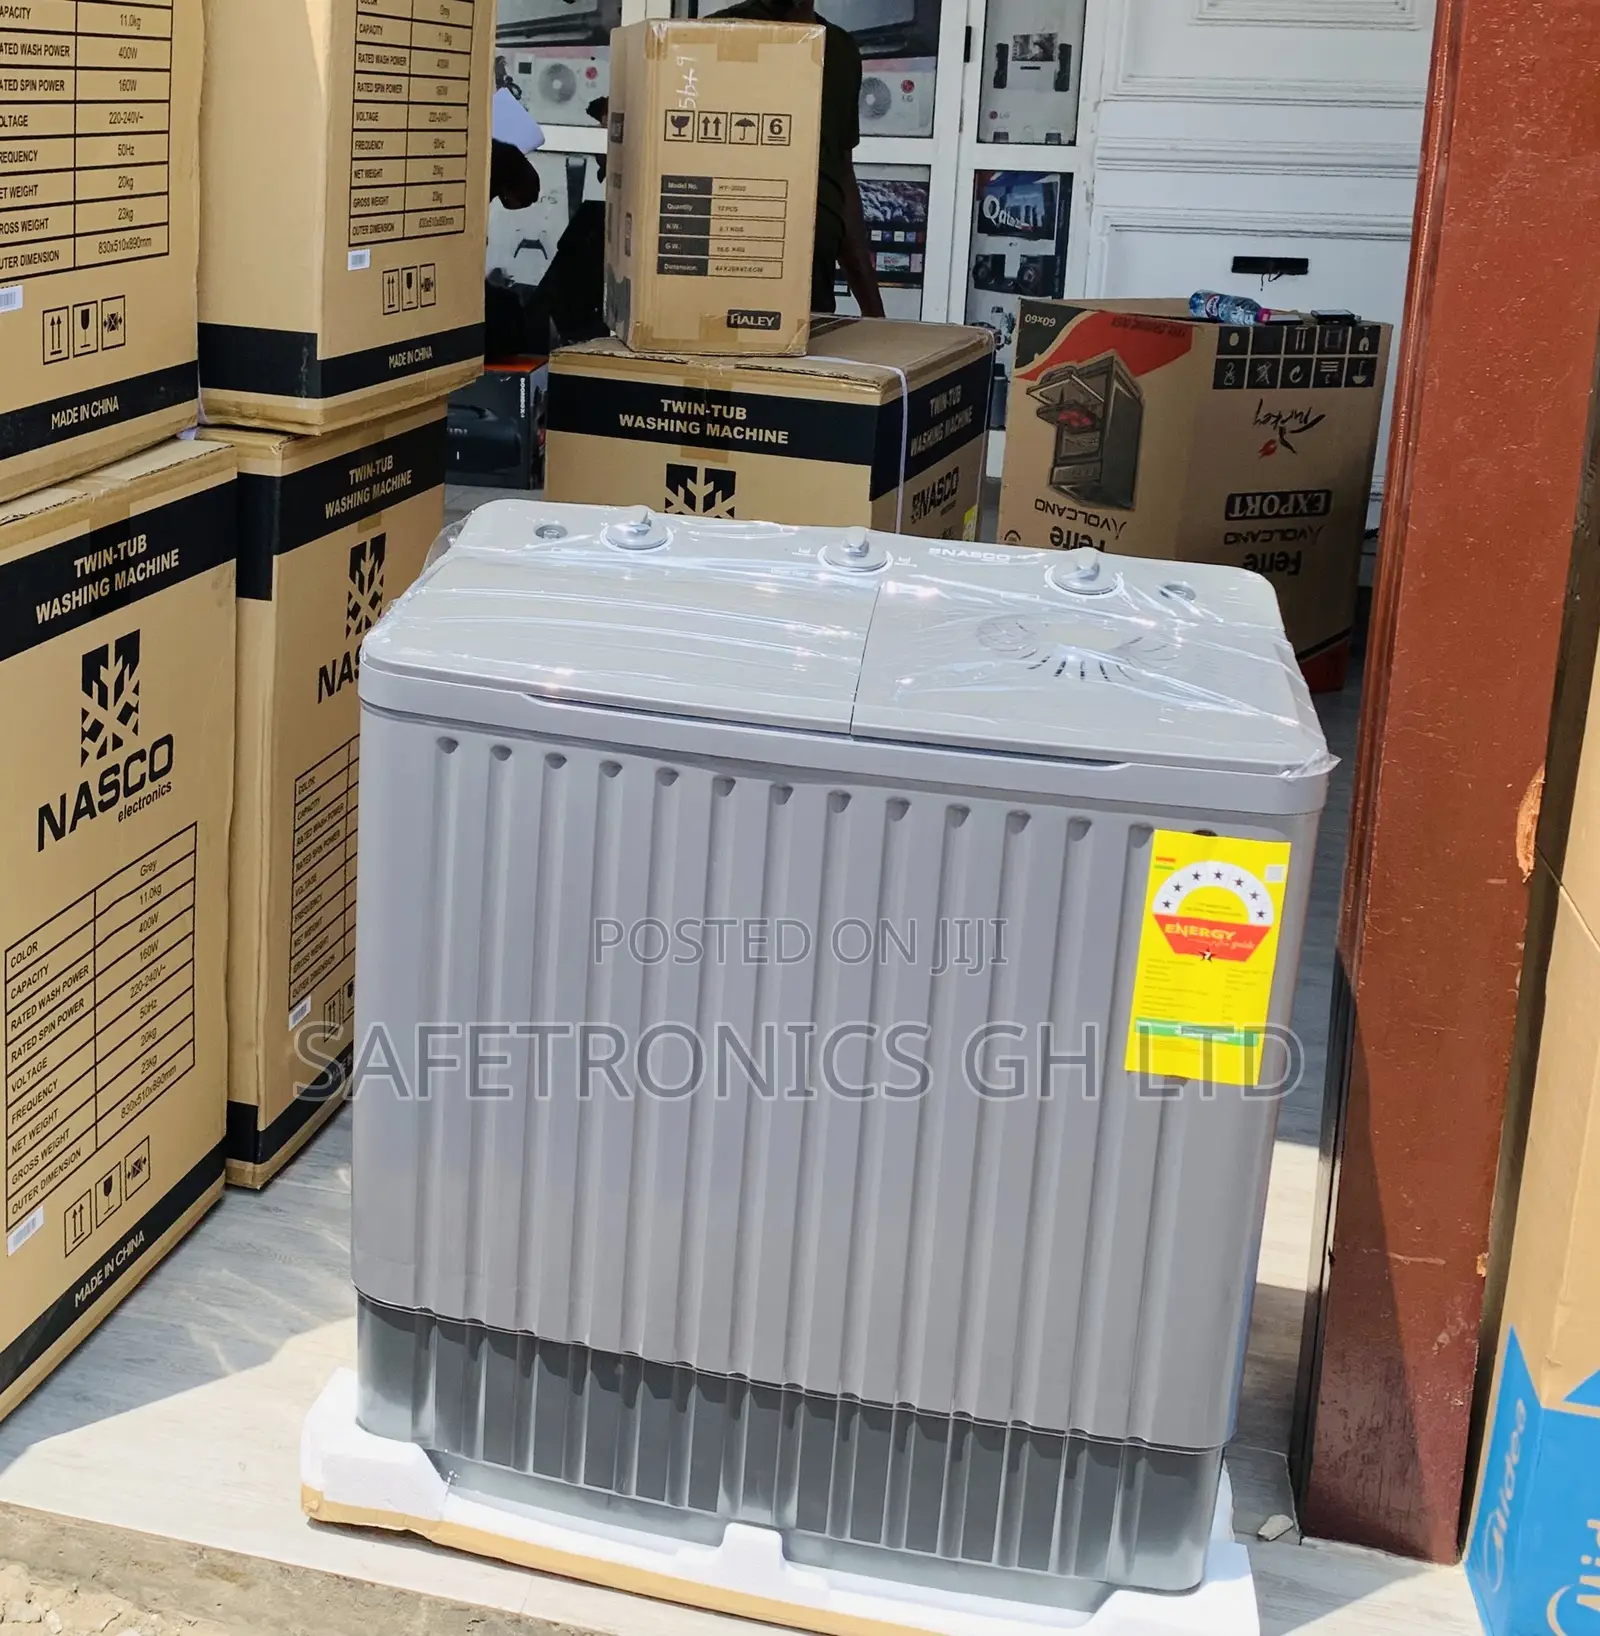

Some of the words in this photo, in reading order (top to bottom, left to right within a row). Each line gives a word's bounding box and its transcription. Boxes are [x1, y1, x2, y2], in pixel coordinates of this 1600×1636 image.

[120, 14, 141, 30] 11.0kg
[20, 44, 42, 56] WASH
[44, 45, 70, 57] POWER
[20, 80, 37, 91] SPIN
[39, 80, 65, 92] POWER
[769, 118, 783, 136] 6
[118, 144, 135, 157] 50Hz
[9, 184, 39, 198] WEIGHT
[118, 175, 134, 190] 20kg
[21, 218, 49, 232] WEIGHT
[118, 207, 134, 222] 23kg
[20, 250, 60, 267] DIMENSION
[731, 312, 775, 327] HALEY
[1024, 313, 1056, 328] 60x60
[388, 354, 407, 369] MADE
[413, 346, 433, 363] CHINA
[51, 408, 79, 430] MADE
[80, 403, 90, 419] IN
[91, 395, 119, 418] CHINA
[661, 399, 747, 421] TWIN-TUB
[619, 413, 700, 435] WASHING
[706, 423, 789, 445] MACHINE
[349, 454, 394, 486] TWIN-TUB
[325, 488, 370, 520] WASHING
[372, 469, 413, 500] MACHINE
[1227, 492, 1327, 518] EXPORT
[1034, 498, 1111, 532] VOLCANO
[1223, 528, 1308, 546] VOLCANO
[73, 533, 148, 579] TWIN-TUB
[35, 576, 110, 624] WASHING
[115, 548, 180, 592] MACHINE
[38, 733, 174, 853] NASCO
[117, 780, 172, 823] electronics
[140, 860, 157, 877] Grey
[139, 884, 162, 905] 11.0kg
[139, 912, 159, 933] 400W
[1164, 922, 1236, 941] ENERGY
[10, 941, 38, 968] COLOR
[139, 939, 159, 962] 160W
[10, 964, 49, 999] CAPACITY
[10, 1005, 37, 1031] RATED
[38, 988, 61, 1011] WASH
[62, 964, 89, 991] POWER
[139, 999, 158, 1019] 50Hz
[11, 1037, 37, 1063] RATED
[38, 1021, 56, 1041] SPIN
[57, 997, 85, 1025] POWER
[141, 1028, 157, 1047] 20kg
[11, 1057, 48, 1093] VOLTAGE
[141, 1055, 157, 1074] 23kg
[11, 1079, 58, 1125] FREQUENCY
[11, 1137, 29, 1155] NET
[29, 1108, 59, 1139] WEIGHT
[11, 1158, 39, 1186] GROSS
[40, 1128, 70, 1165] WEIGHT
[11, 1186, 39, 1216] OUTER
[40, 1147, 82, 1191] DIMENSION
[74, 1269, 104, 1308] MADE
[104, 1258, 115, 1280] IN
[116, 1230, 145, 1267] CHINA
